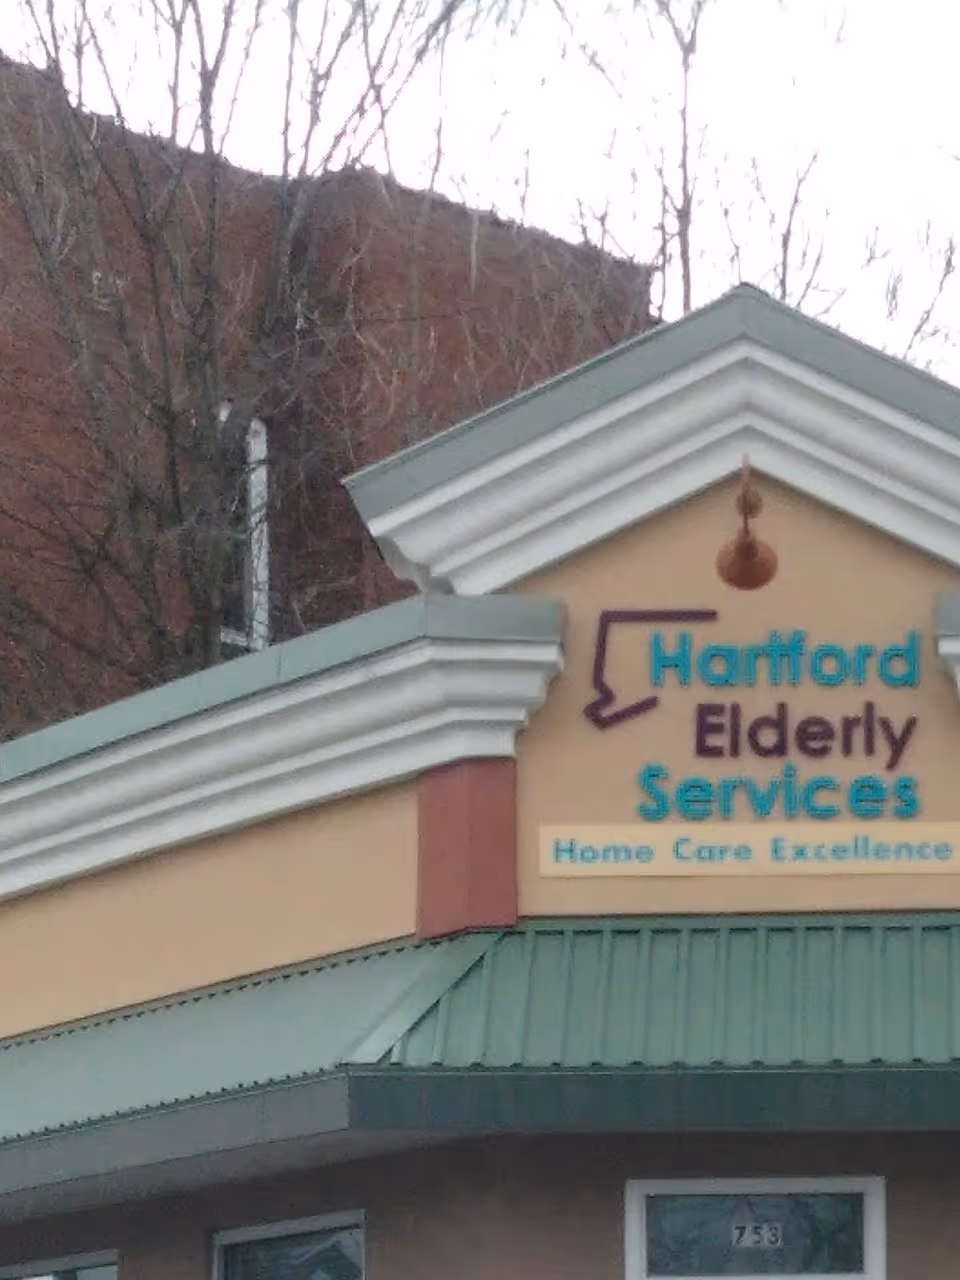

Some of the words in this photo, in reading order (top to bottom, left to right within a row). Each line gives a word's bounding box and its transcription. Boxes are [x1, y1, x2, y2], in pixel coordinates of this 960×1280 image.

[650, 630, 919, 689] Hartford
[695, 702, 917, 770] Elderly
[636, 761, 920, 821] Services
[553, 838, 654, 864] Home
[672, 837, 753, 862] Care
[770, 836, 953, 862] Excellence
[735, 1225, 780, 1245] 753
